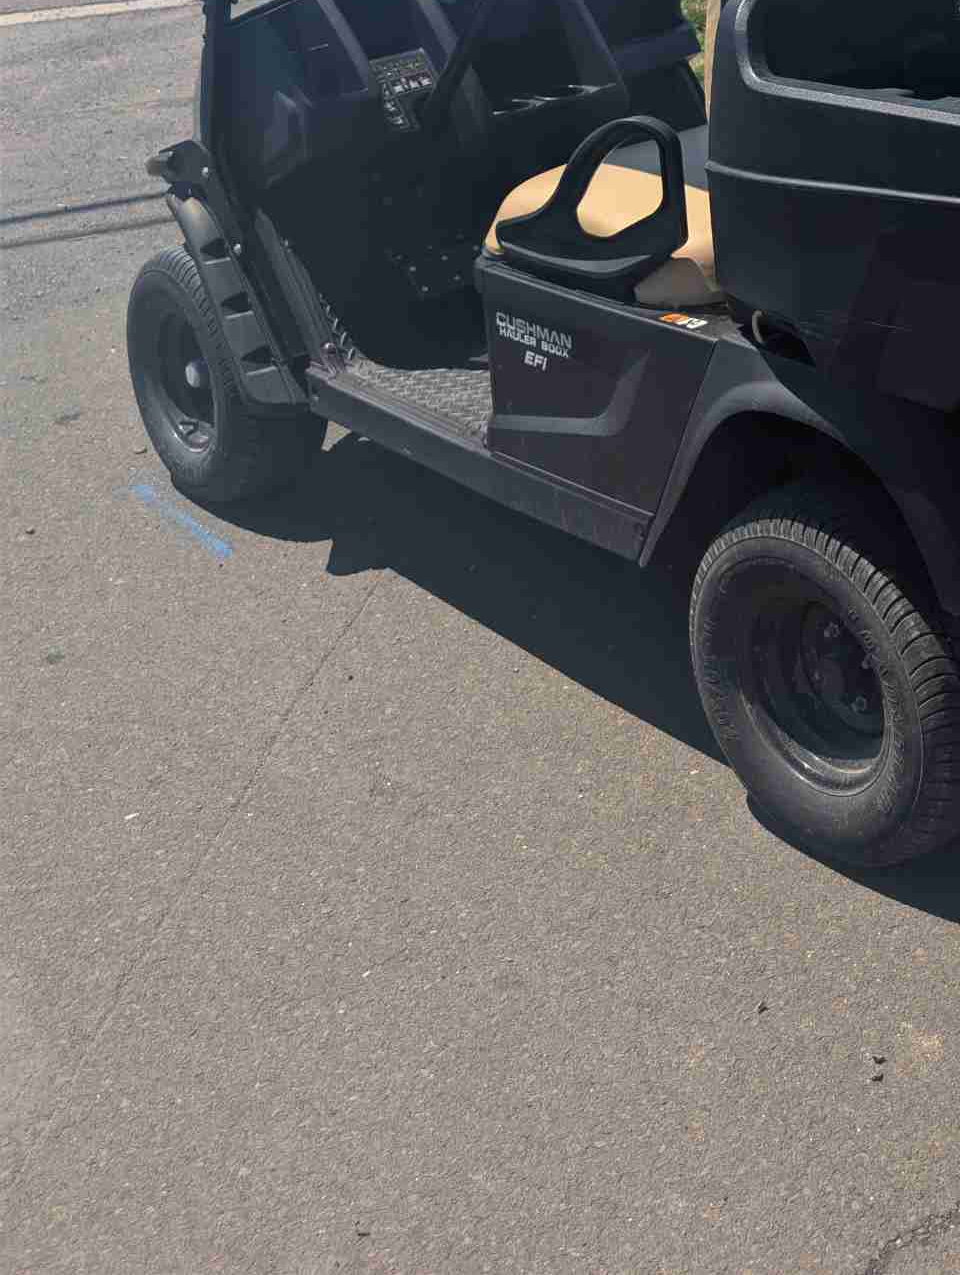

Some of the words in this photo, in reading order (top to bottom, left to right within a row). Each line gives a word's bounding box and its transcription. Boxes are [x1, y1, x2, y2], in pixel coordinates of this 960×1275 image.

[495, 311, 572, 350] CUSHMAN
[499, 326, 536, 347] HAULER
[524, 350, 547, 371] EFI
